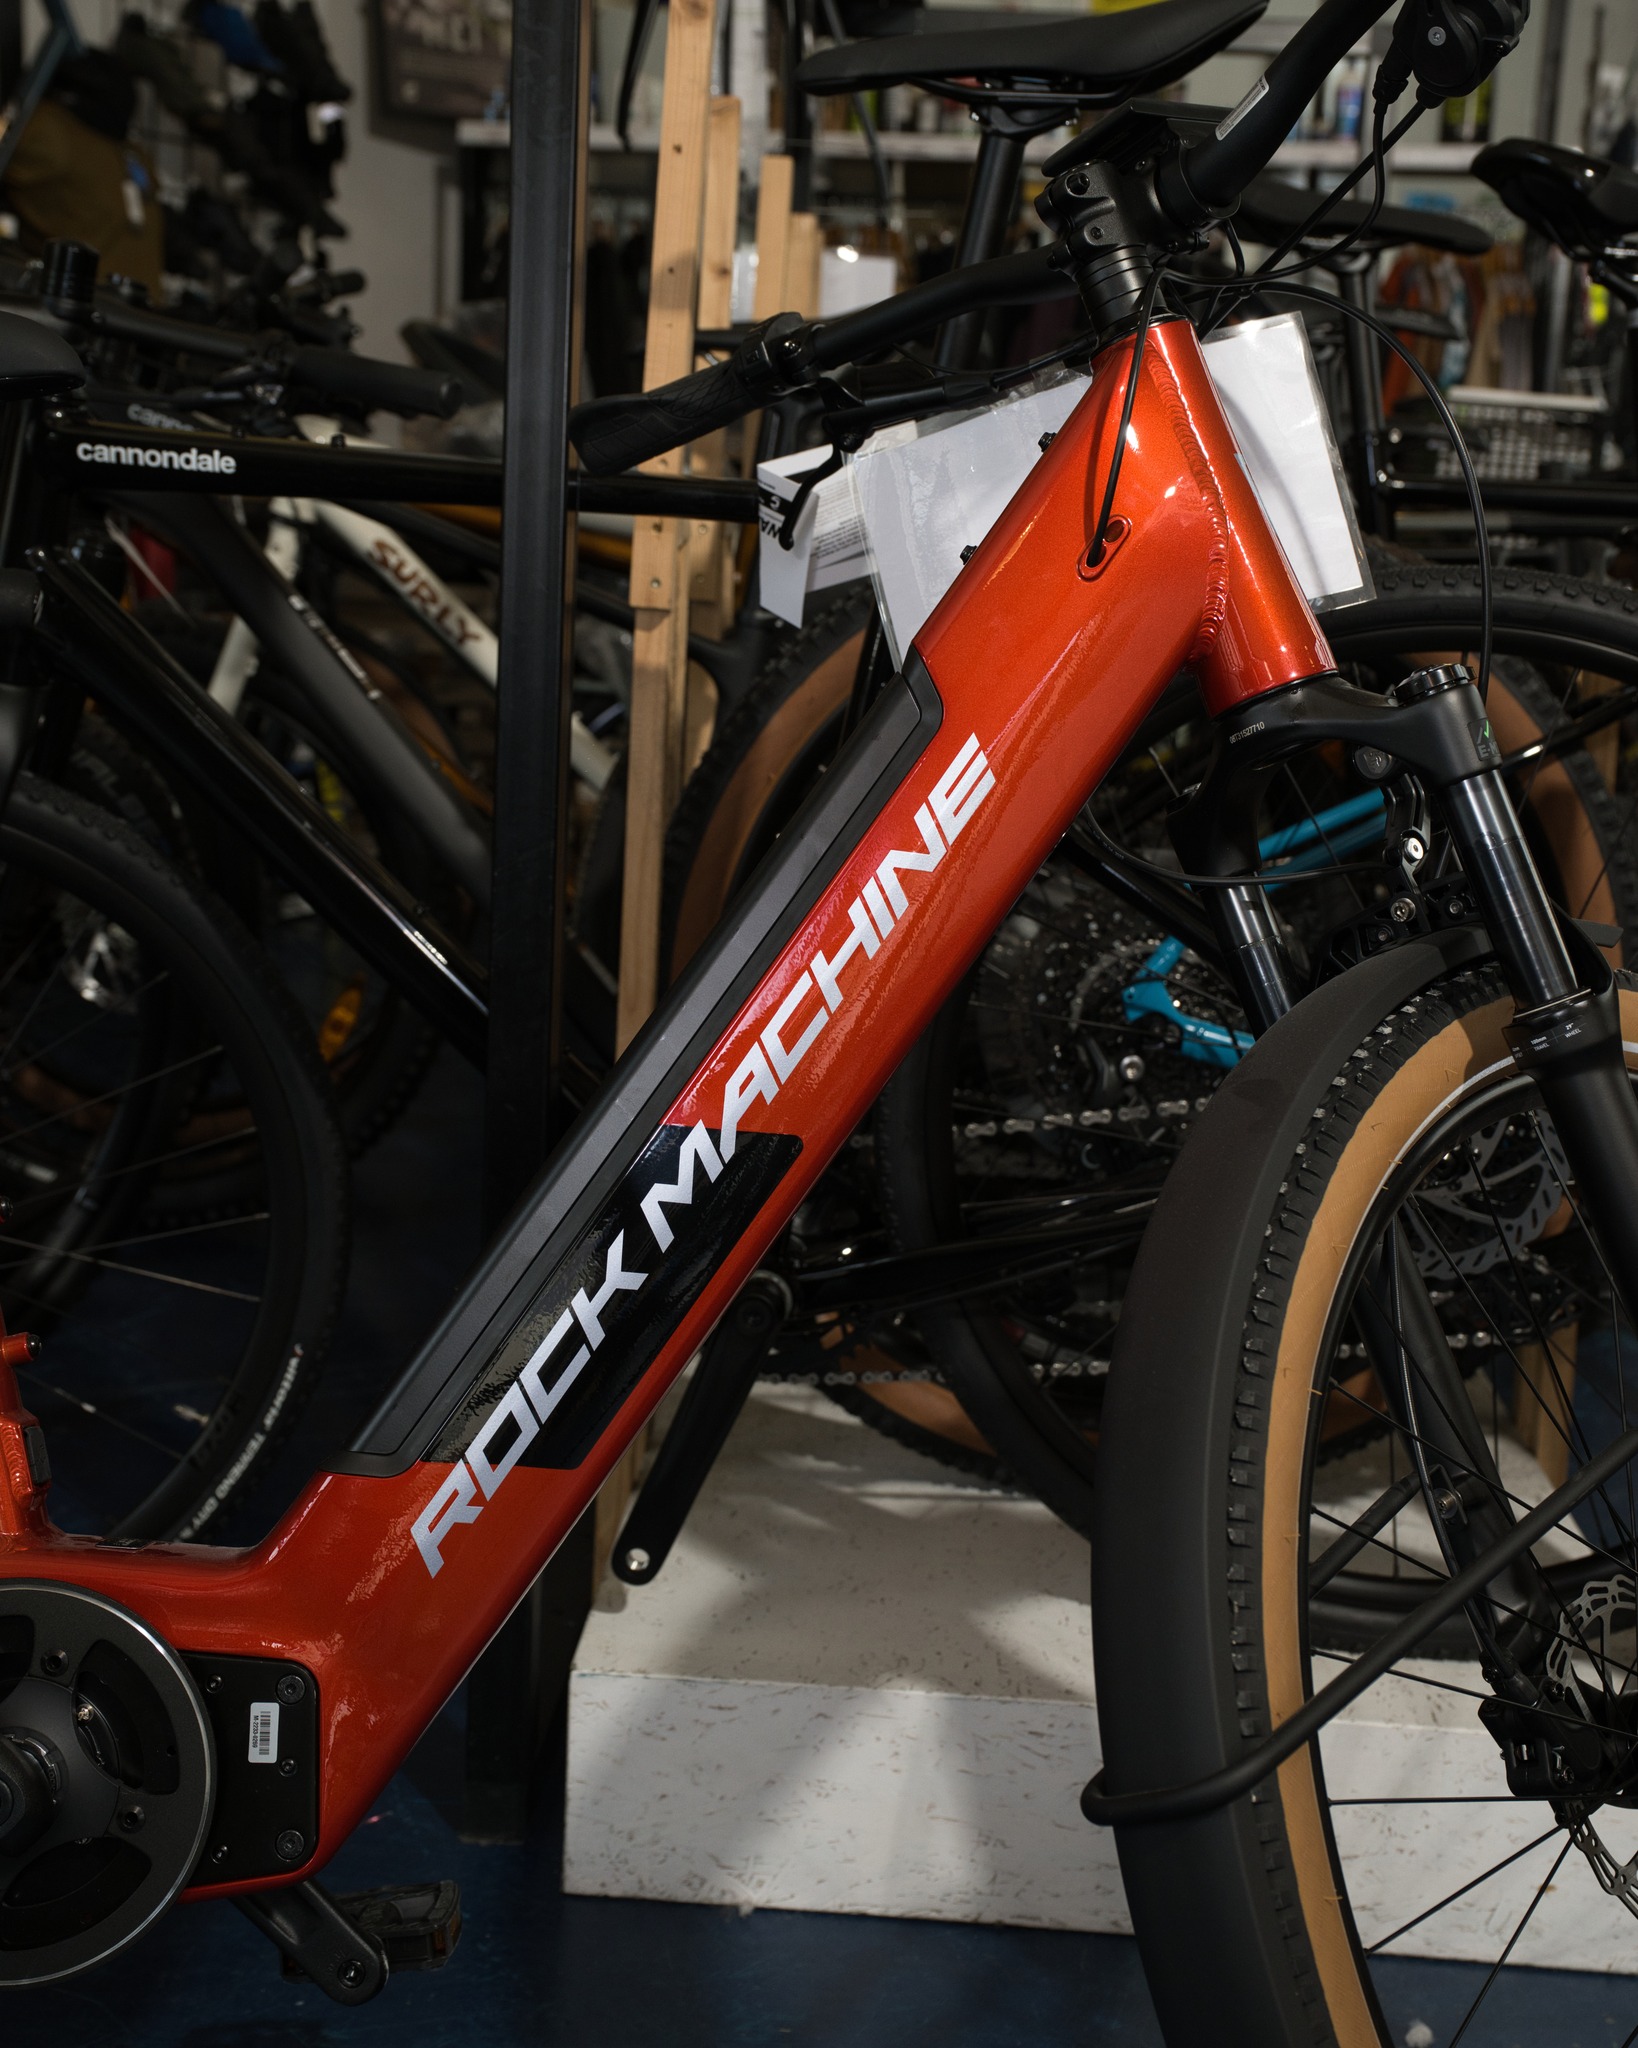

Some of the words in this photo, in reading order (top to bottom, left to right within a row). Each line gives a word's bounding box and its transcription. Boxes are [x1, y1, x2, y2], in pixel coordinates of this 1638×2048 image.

[76, 441, 237, 475] cannondale
[368, 538, 482, 645] SURLY
[1534, 1042, 1550, 1051] TRAVEL
[1564, 1028, 1582, 1038] WHEEL
[410, 1228, 649, 1579] ROCK
[640, 732, 997, 1254] MACHINE
[264, 1356, 300, 1430] vittoria
[215, 1432, 266, 1500] TERRENO
[192, 1496, 219, 1530] DRY
